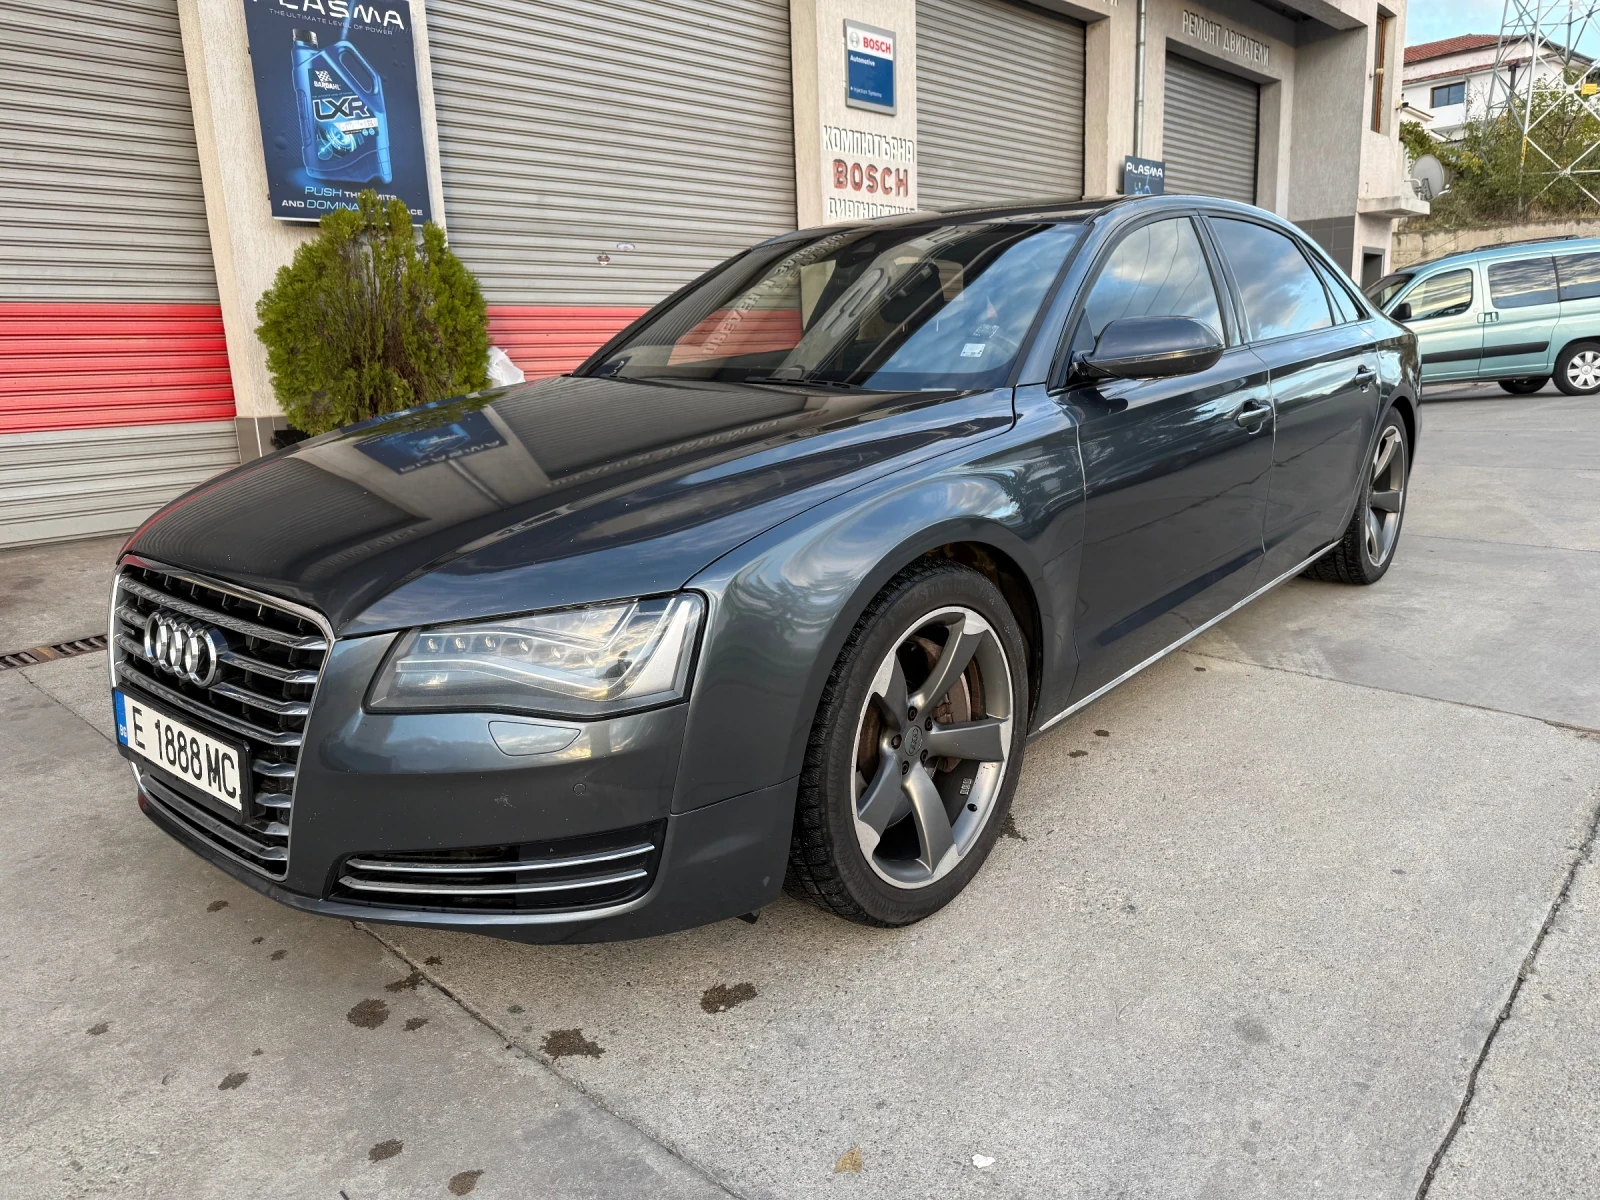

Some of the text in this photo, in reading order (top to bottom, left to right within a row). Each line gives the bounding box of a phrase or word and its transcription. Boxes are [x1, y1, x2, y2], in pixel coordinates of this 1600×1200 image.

[252, 0, 405, 30] LASMA
[268, 8, 285, 16] THE
[286, 10, 327, 24] ULTIMATE
[328, 19, 352, 29] LEVEL
[365, 26, 393, 36] POWER
[863, 36, 891, 54] BOSCH
[1182, 10, 1270, 67] РЕМОНТ ДВИГАТЕЛИ
[849, 54, 876, 67] Automotive
[313, 95, 370, 122] LXR
[833, 158, 909, 198] BOSCH
[1126, 162, 1163, 178] PLASMA
[305, 186, 342, 197] PUSH
[282, 199, 305, 208] AND
[307, 199, 360, 212] DOMINA
[119, 724, 128, 738] BG
[132, 705, 237, 799] E 1888 MC
